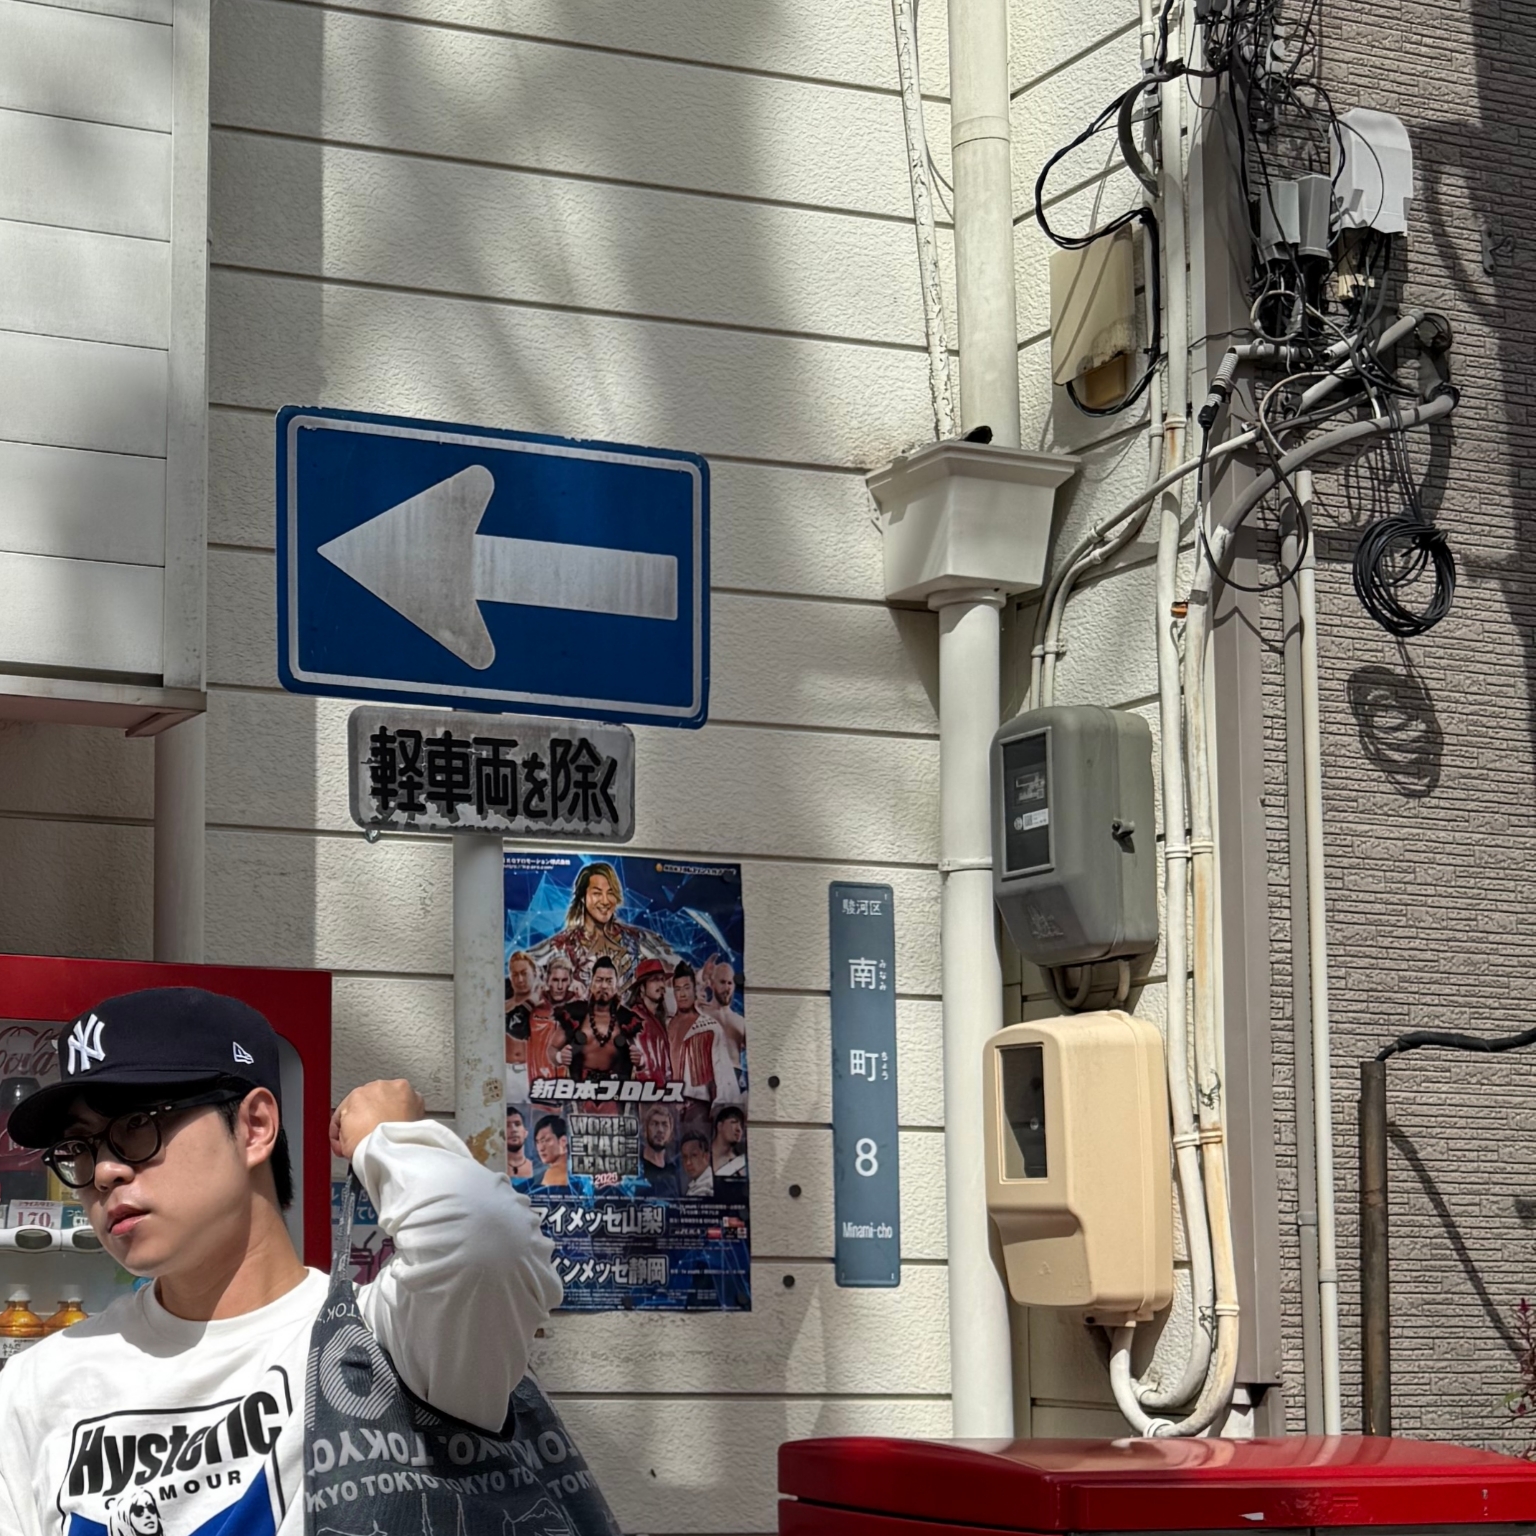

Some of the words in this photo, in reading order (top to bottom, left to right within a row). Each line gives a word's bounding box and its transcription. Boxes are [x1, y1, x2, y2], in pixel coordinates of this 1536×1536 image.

[369, 725, 619, 823] 軽車両を除く
[841, 898, 883, 917] 駿河区
[67, 1013, 106, 1075] NY
[530, 1078, 685, 1102] 新日本プロレス
[571, 1116, 638, 1136] WORLD
[583, 1135, 625, 1156] TAG
[571, 1155, 639, 1175] LEAGUE
[854, 1137, 880, 1178] 8
[842, 1220, 894, 1240] Minami-cho
[68, 1391, 283, 1497] Hysteric
